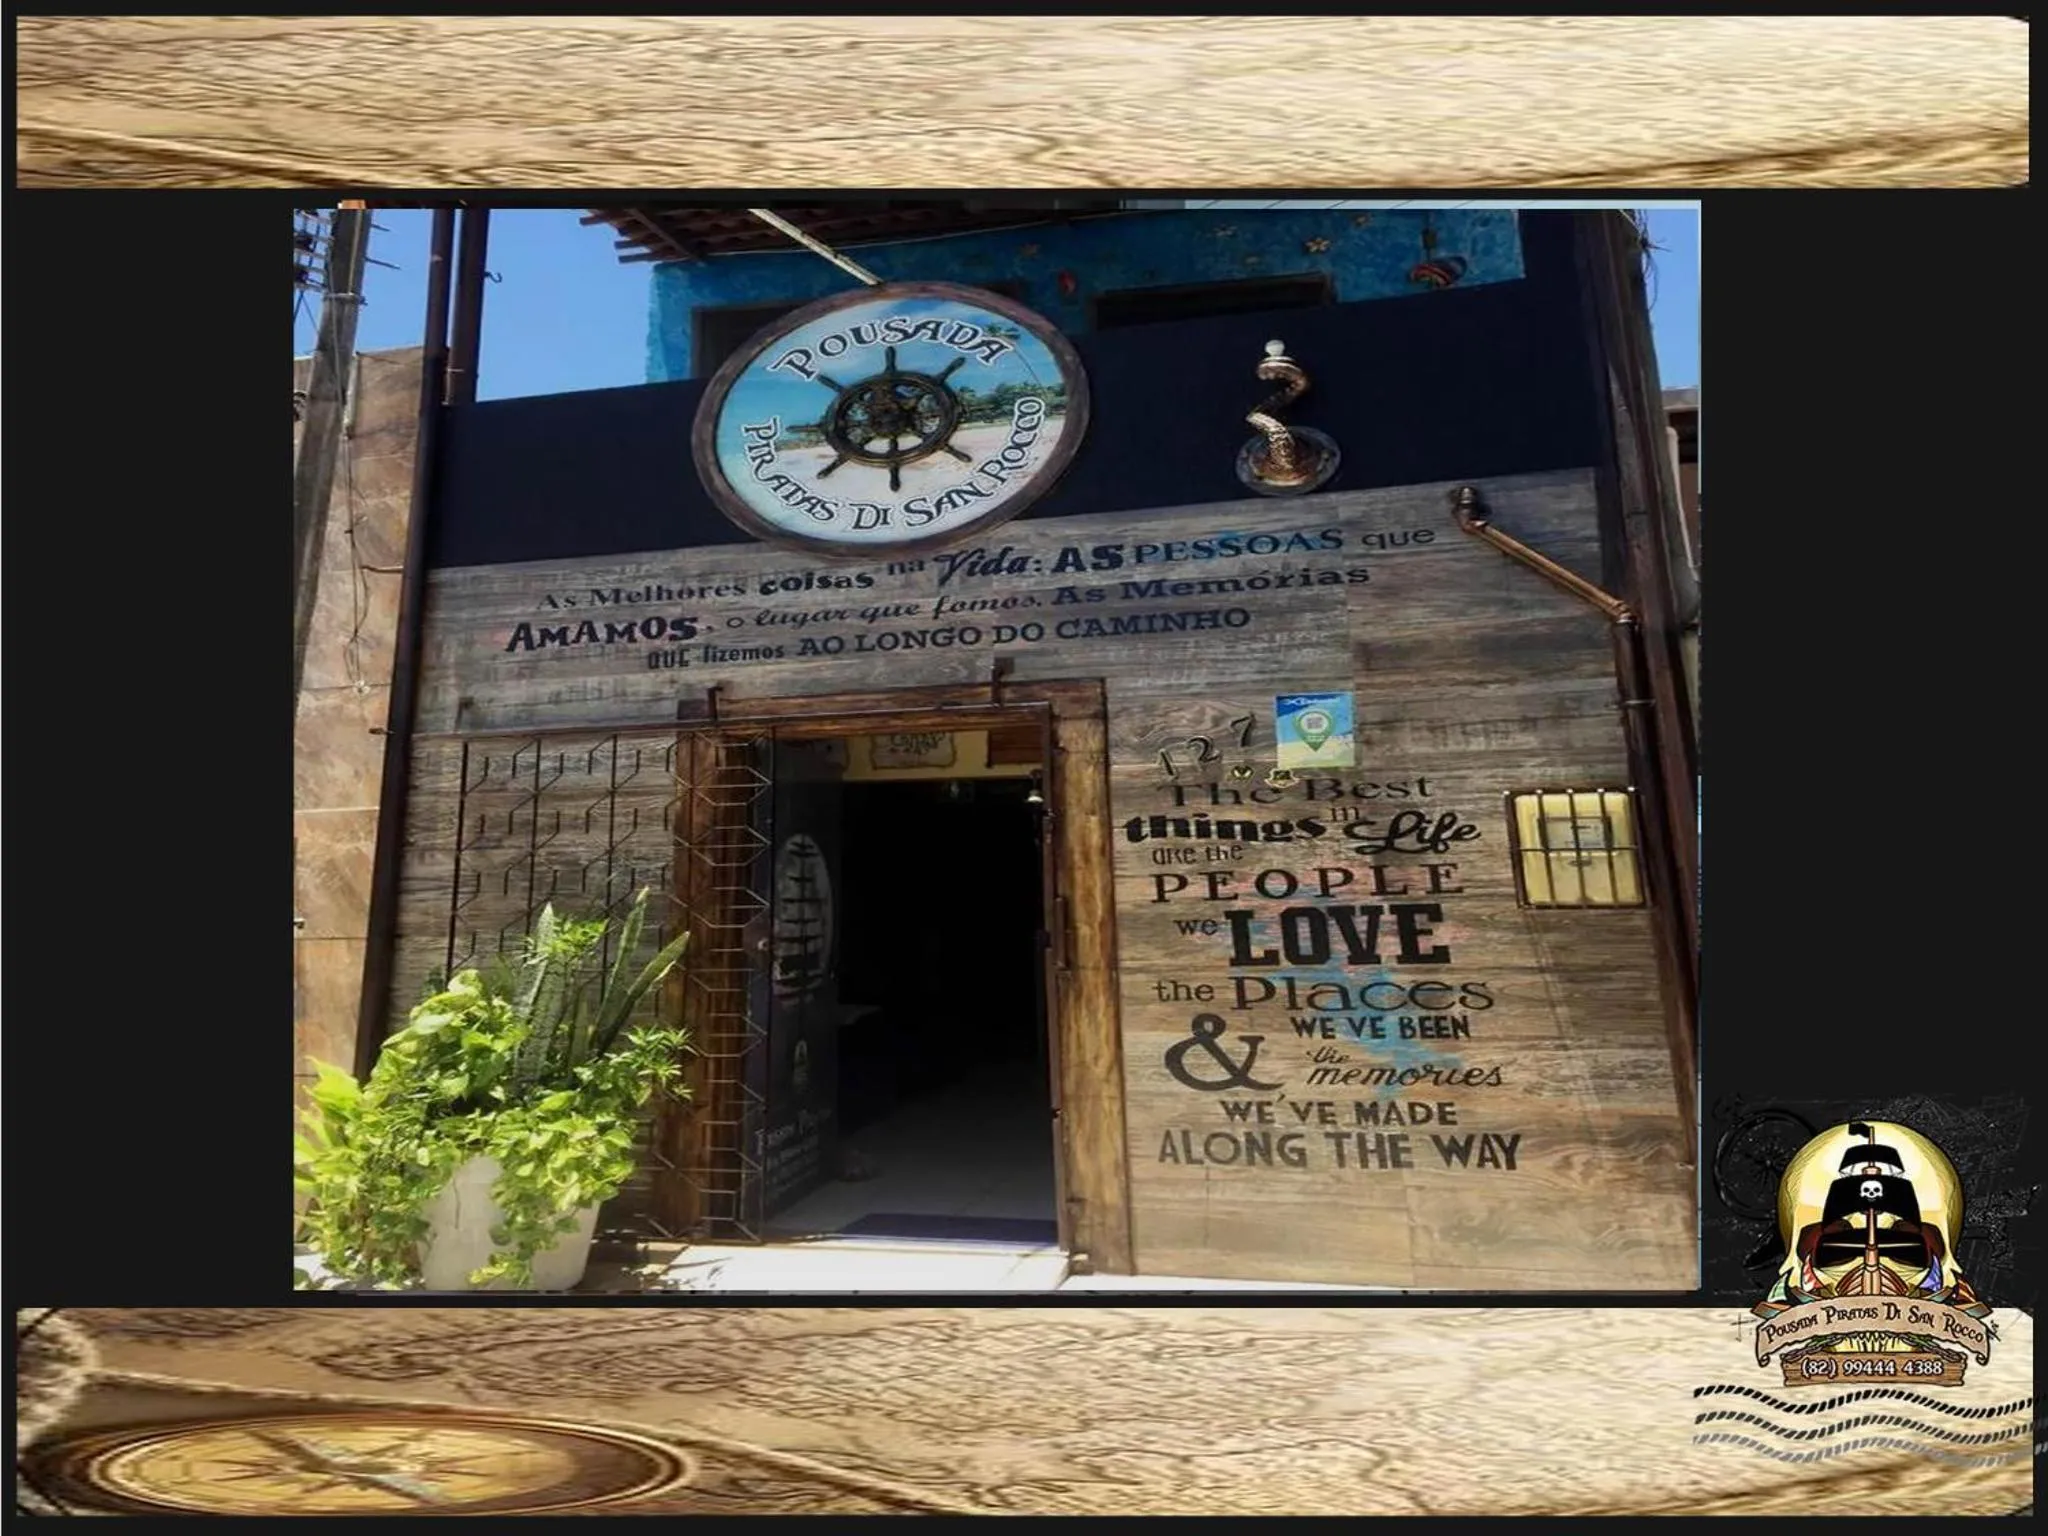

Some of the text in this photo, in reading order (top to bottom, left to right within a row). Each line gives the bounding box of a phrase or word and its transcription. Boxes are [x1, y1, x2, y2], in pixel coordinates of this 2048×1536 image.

[768, 316, 1014, 380] POUSADA
[743, 398, 1044, 530] PIRATAS DI SAN ROCCO
[536, 528, 1435, 610] As Melhores coisas na Vida: AS PESSOAS que
[755, 608, 851, 631] lugar
[859, 601, 921, 624] que
[1051, 586, 1107, 606] As
[797, 635, 847, 657] AO
[855, 624, 982, 652] LONGO
[992, 622, 1045, 644] DO
[1055, 608, 1250, 640] CAMINHO
[1157, 775, 1434, 807] The Best
[1123, 812, 1327, 843] things
[1343, 810, 1481, 855] Life
[1205, 844, 1244, 862] the
[1150, 862, 1465, 904] PEOPLE
[1174, 903, 1451, 967] we LOVE
[1152, 976, 1494, 1011] the Places
[1398, 1015, 1471, 1040] BEEN
[1164, 1012, 1285, 1092] &
[1306, 1063, 1504, 1088] memories
[1218, 1093, 1459, 1127] WE'VE MADE
[1157, 1129, 1523, 1171] ALONG THE WAY
